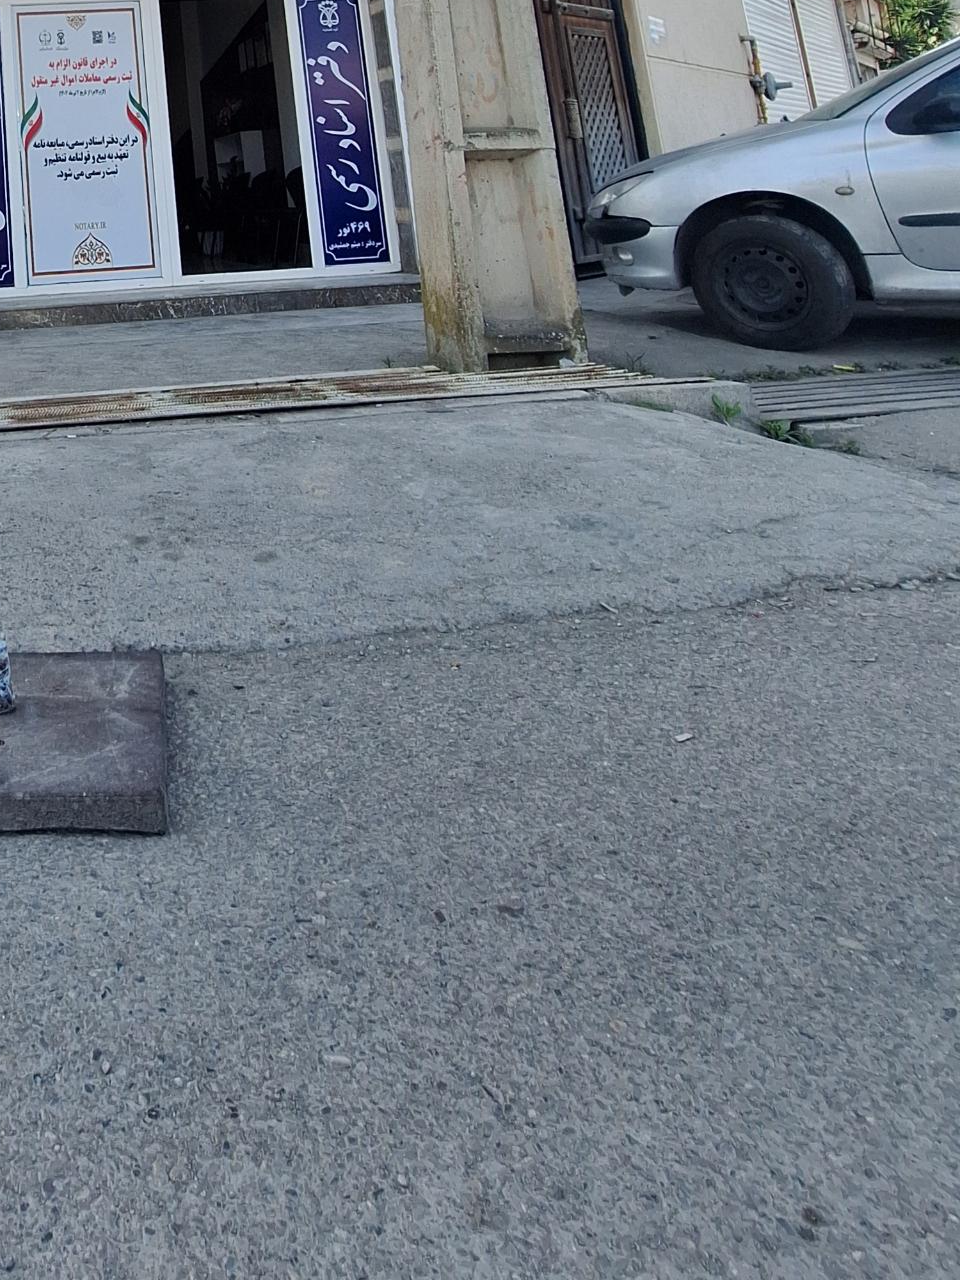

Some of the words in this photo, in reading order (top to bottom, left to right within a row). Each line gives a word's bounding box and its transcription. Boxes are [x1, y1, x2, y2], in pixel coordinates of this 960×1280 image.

[56, 58, 71, 71] الزام
[72, 56, 88, 70] قانون
[89, 56, 109, 69] اجرای
[110, 57, 118, 69] در
[121, 70, 133, 83] ثبت
[307, 41, 366, 100] دفتر
[50, 75, 59, 87] غیر
[61, 73, 78, 86] اموال
[79, 73, 102, 83] معاملات
[102, 74, 121, 84] رسمی
[316, 99, 362, 152] اسناد
[105, 134, 119, 148] دفتر
[119, 133, 130, 147] این
[130, 135, 139, 147] در
[48, 152, 67, 167] تنظیم
[96, 153, 107, 163] بیع
[114, 149, 129, 162] تعهد
[85, 170, 106, 180] رسمی
[105, 164, 119, 178] ثبت
[326, 158, 378, 212] رسمی
[74, 221, 107, 231] NOTARY.IR
[337, 223, 350, 237] نور
[350, 221, 371, 234] ۴۶۹
